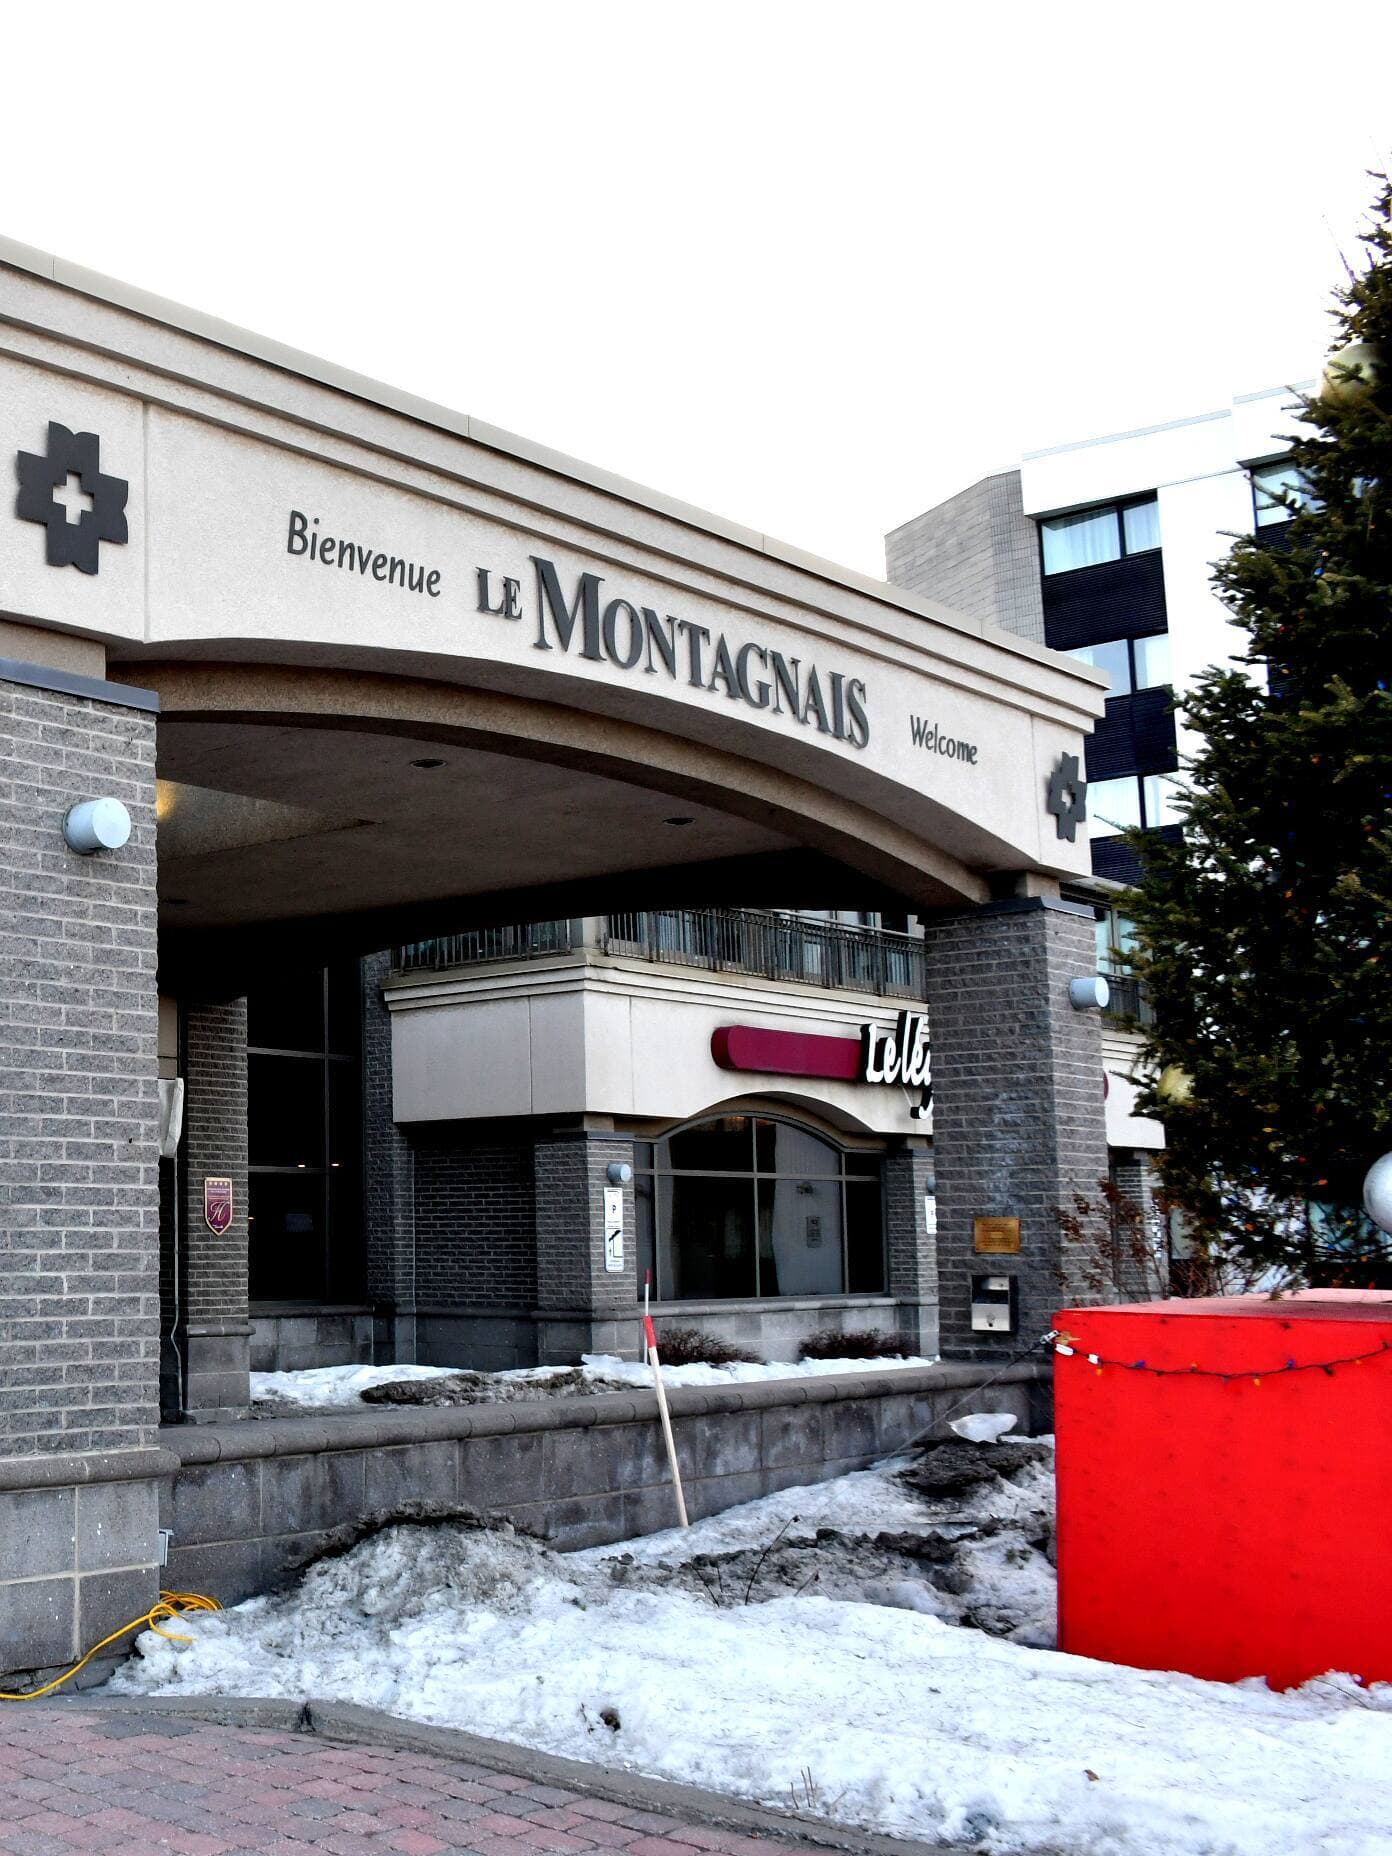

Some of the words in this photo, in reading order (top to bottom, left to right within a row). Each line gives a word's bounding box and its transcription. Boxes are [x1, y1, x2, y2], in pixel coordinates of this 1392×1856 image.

[287, 510, 441, 598] Bienvenue
[474, 567, 523, 620] LE
[529, 555, 870, 750] MONTAGNAIS
[909, 714, 978, 766] Welcome
